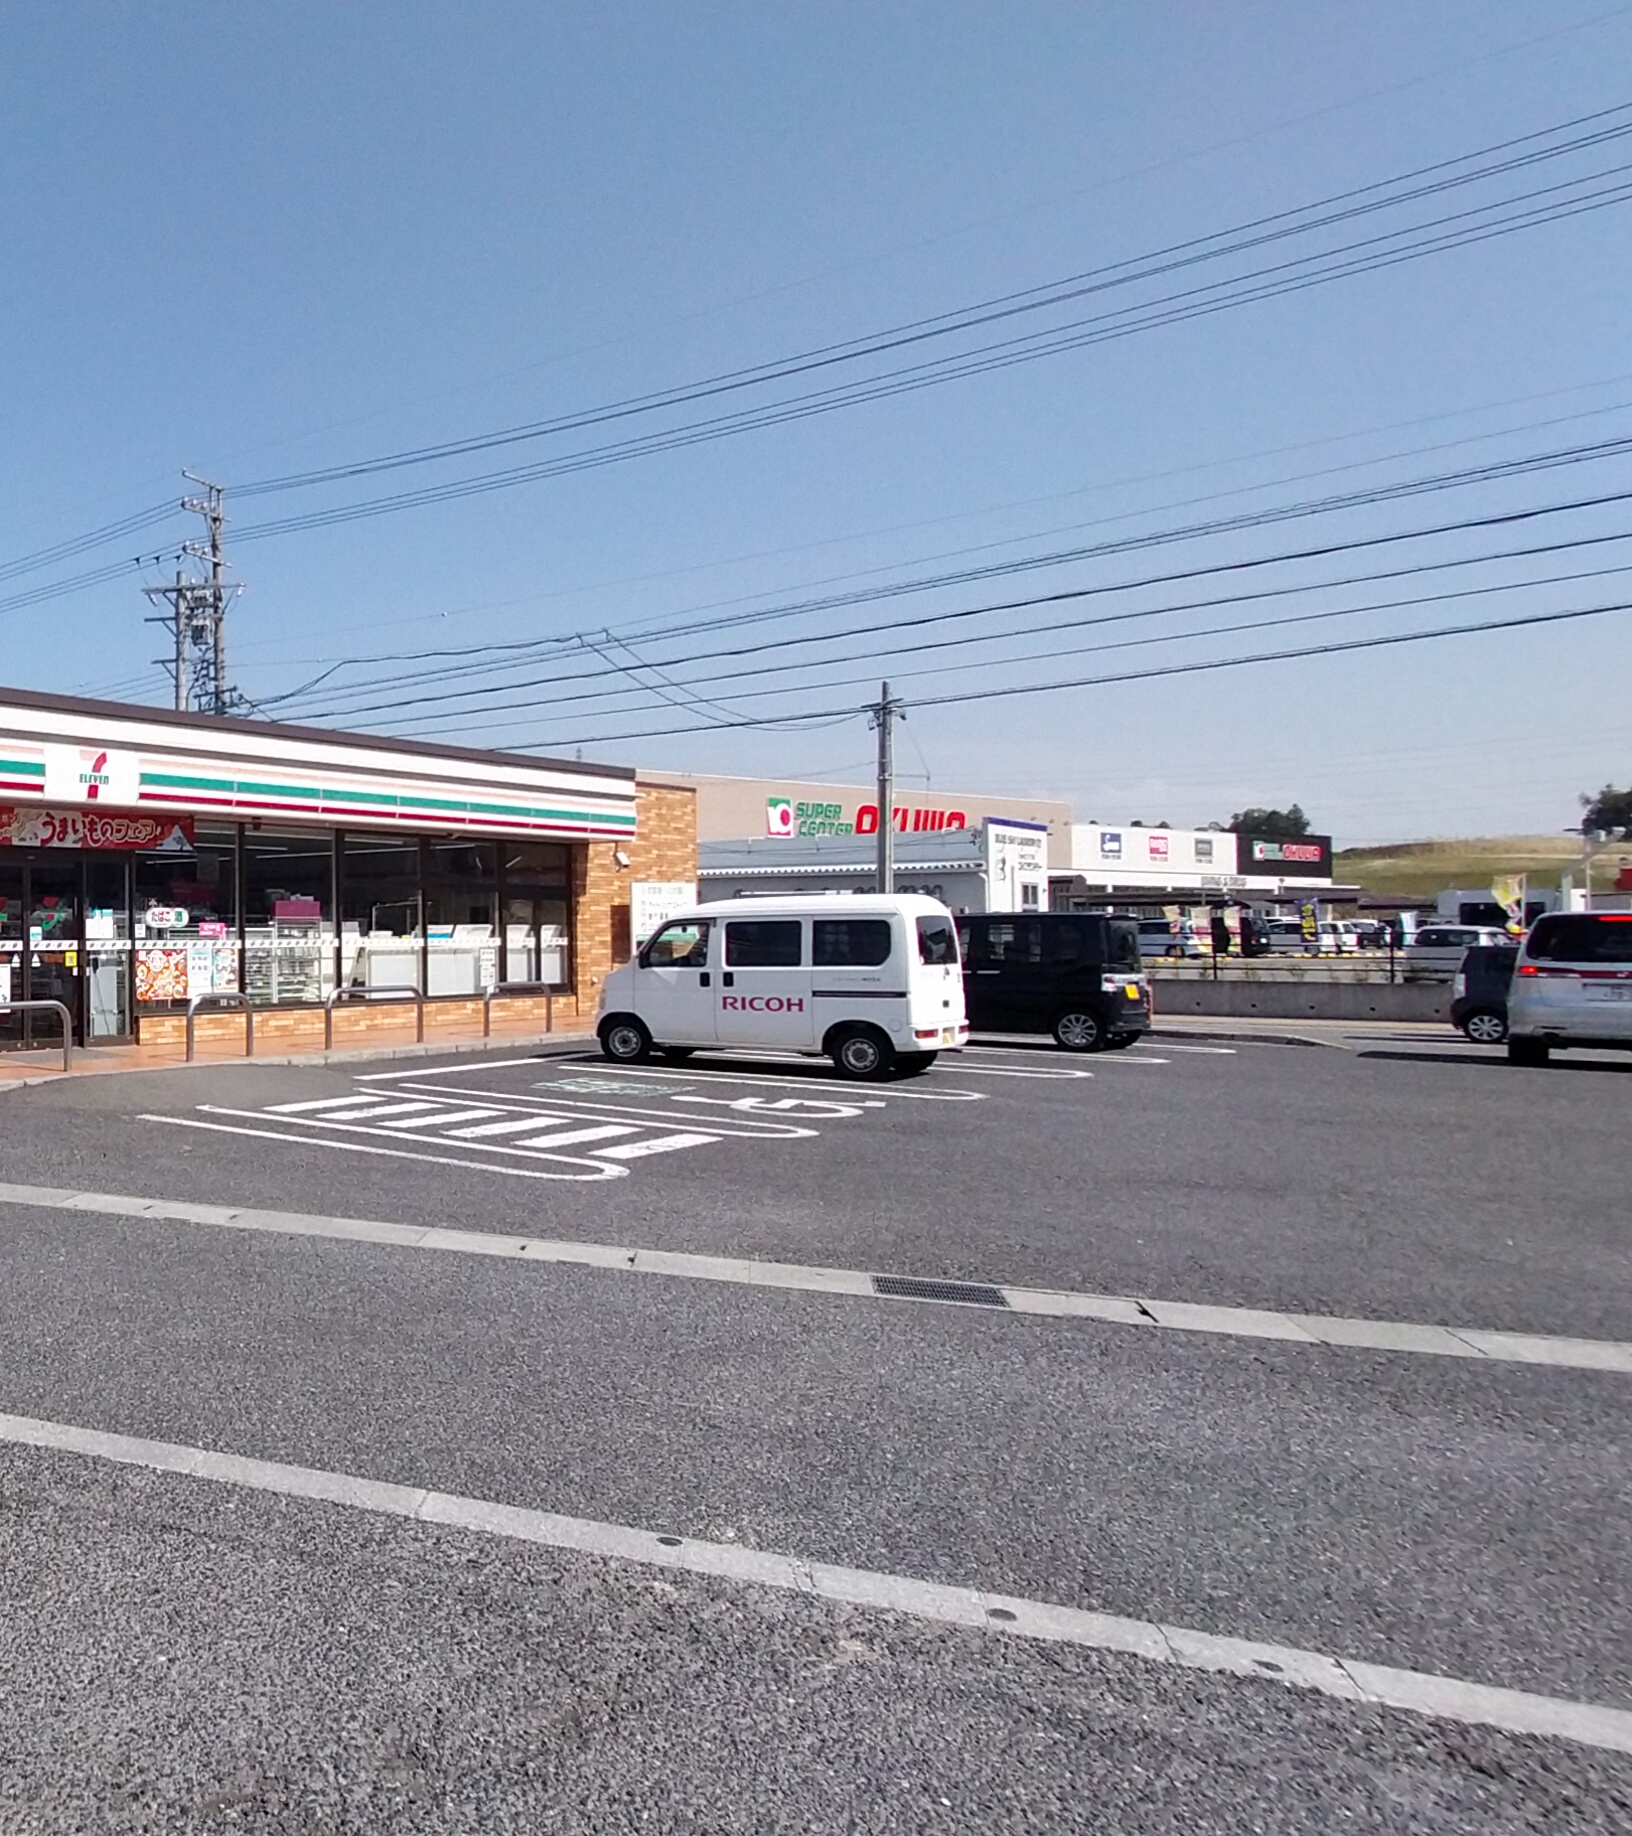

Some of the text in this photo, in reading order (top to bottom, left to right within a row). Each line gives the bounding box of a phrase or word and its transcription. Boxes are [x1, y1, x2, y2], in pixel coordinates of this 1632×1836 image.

[796, 801, 842, 820] SUPER
[798, 820, 853, 837] CENTER
[722, 996, 804, 1012] RICOH
